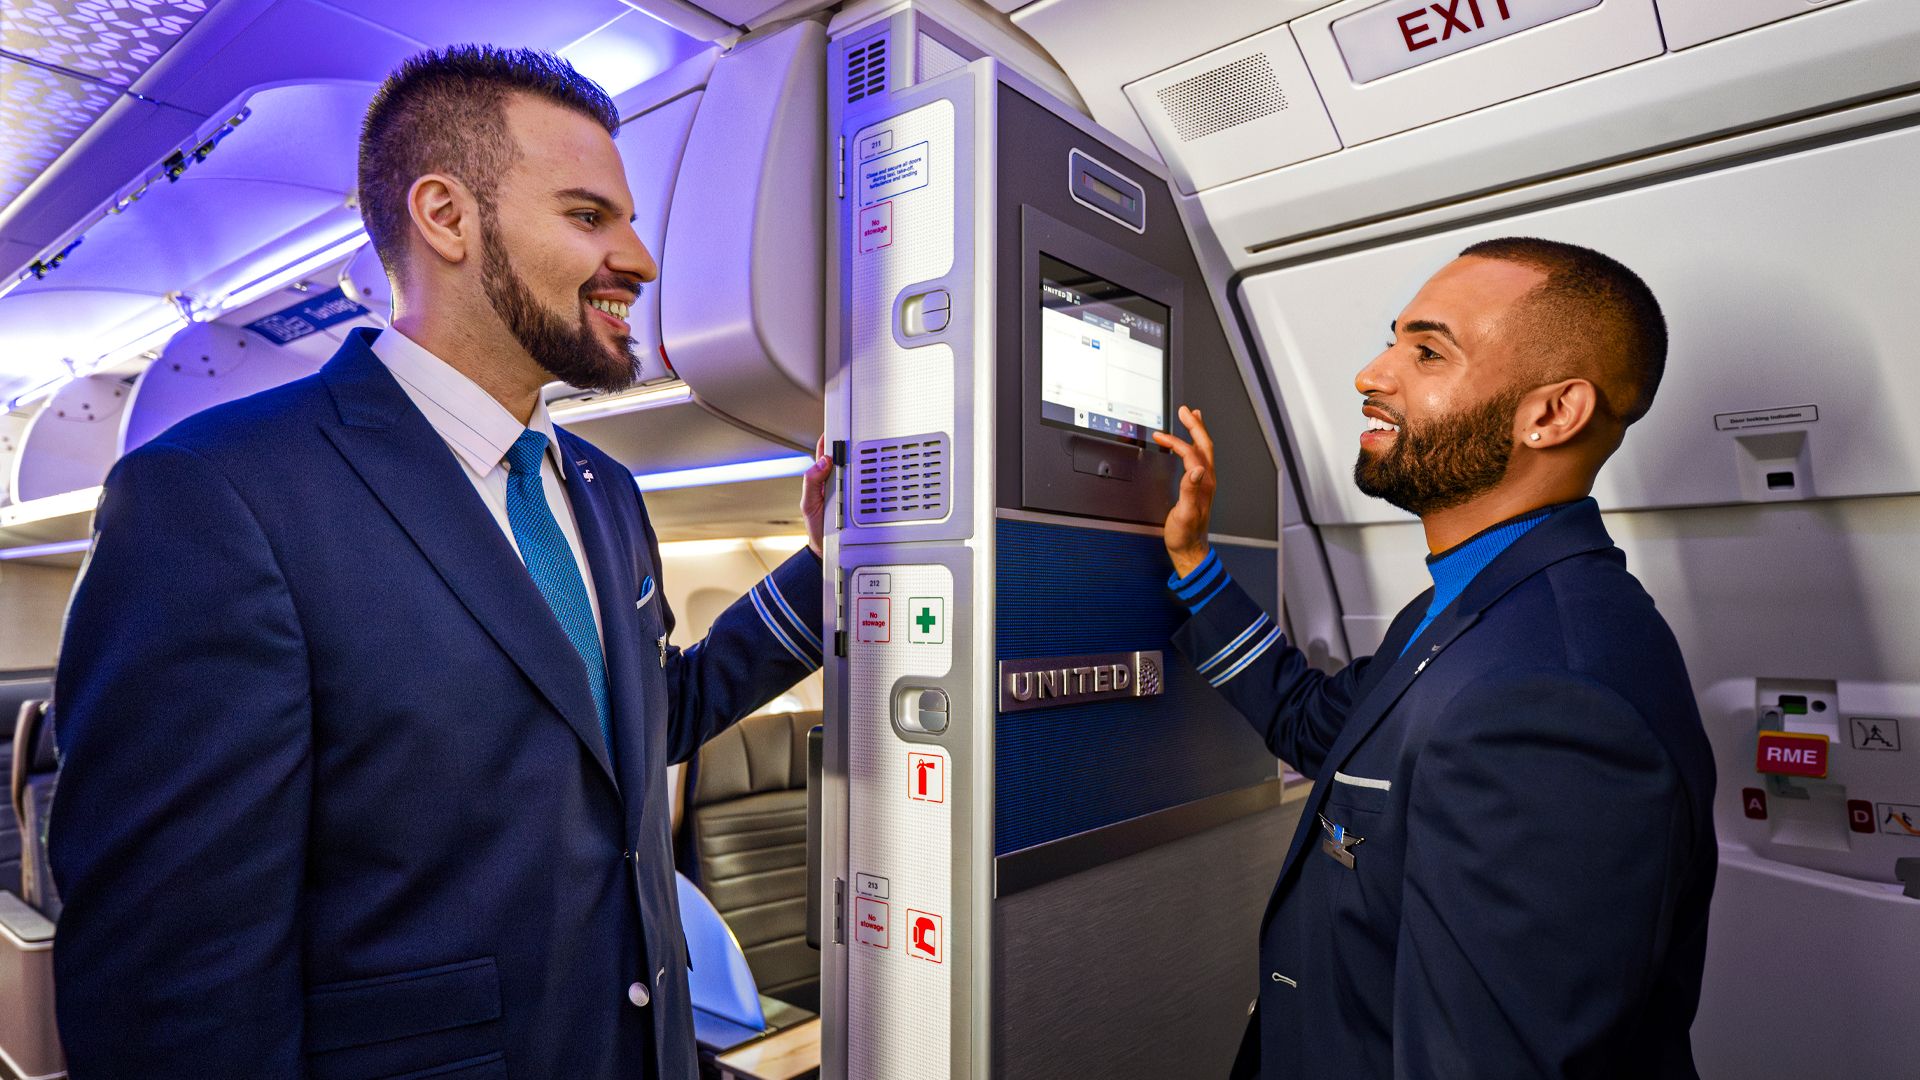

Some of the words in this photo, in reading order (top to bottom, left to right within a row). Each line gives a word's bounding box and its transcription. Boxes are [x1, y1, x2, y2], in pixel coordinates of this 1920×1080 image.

[871, 140, 881, 149] 211
[902, 170, 918, 178] landing
[871, 219, 880, 227] No
[864, 225, 888, 237] stowage
[1043, 284, 1066, 298] UNITED
[862, 620, 885, 628] stowage
[1012, 664, 1131, 701] UNITED
[1767, 746, 1818, 765] RME
[1749, 798, 1763, 811] A
[1853, 810, 1870, 824] D
[867, 881, 879, 890] 213
[867, 913, 876, 921] No
[861, 921, 884, 932] stowage
